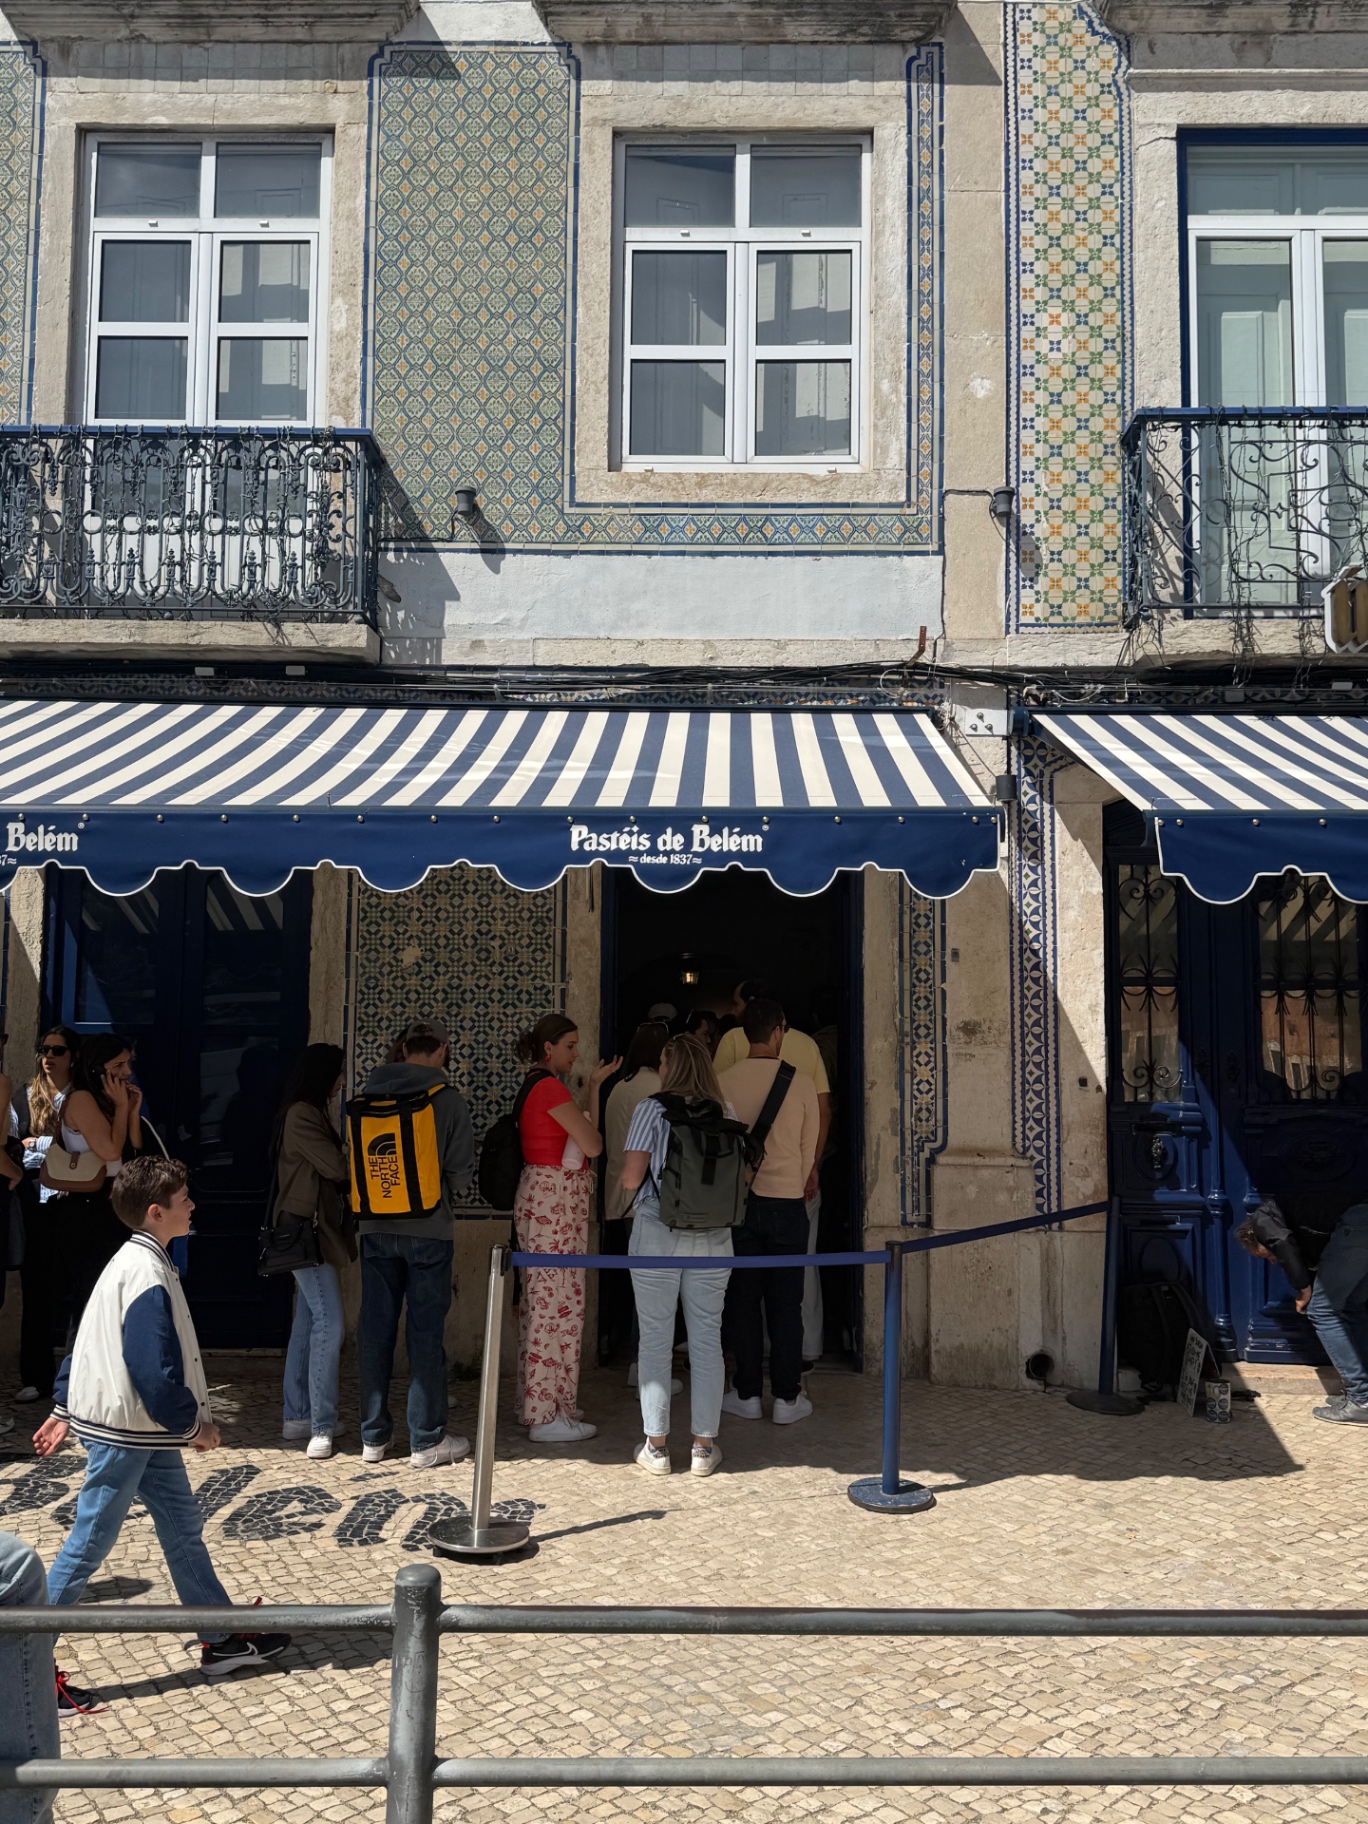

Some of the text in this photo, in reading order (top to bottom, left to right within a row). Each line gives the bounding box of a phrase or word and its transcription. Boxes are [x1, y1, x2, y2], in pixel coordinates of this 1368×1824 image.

[5, 822, 79, 852] Belém
[570, 824, 763, 852] Pastéis de Belém
[640, 853, 693, 865] desde 1837
[368, 1155, 380, 1180] THE
[377, 1156, 392, 1199] NORTH
[388, 1155, 401, 1187] FACE
